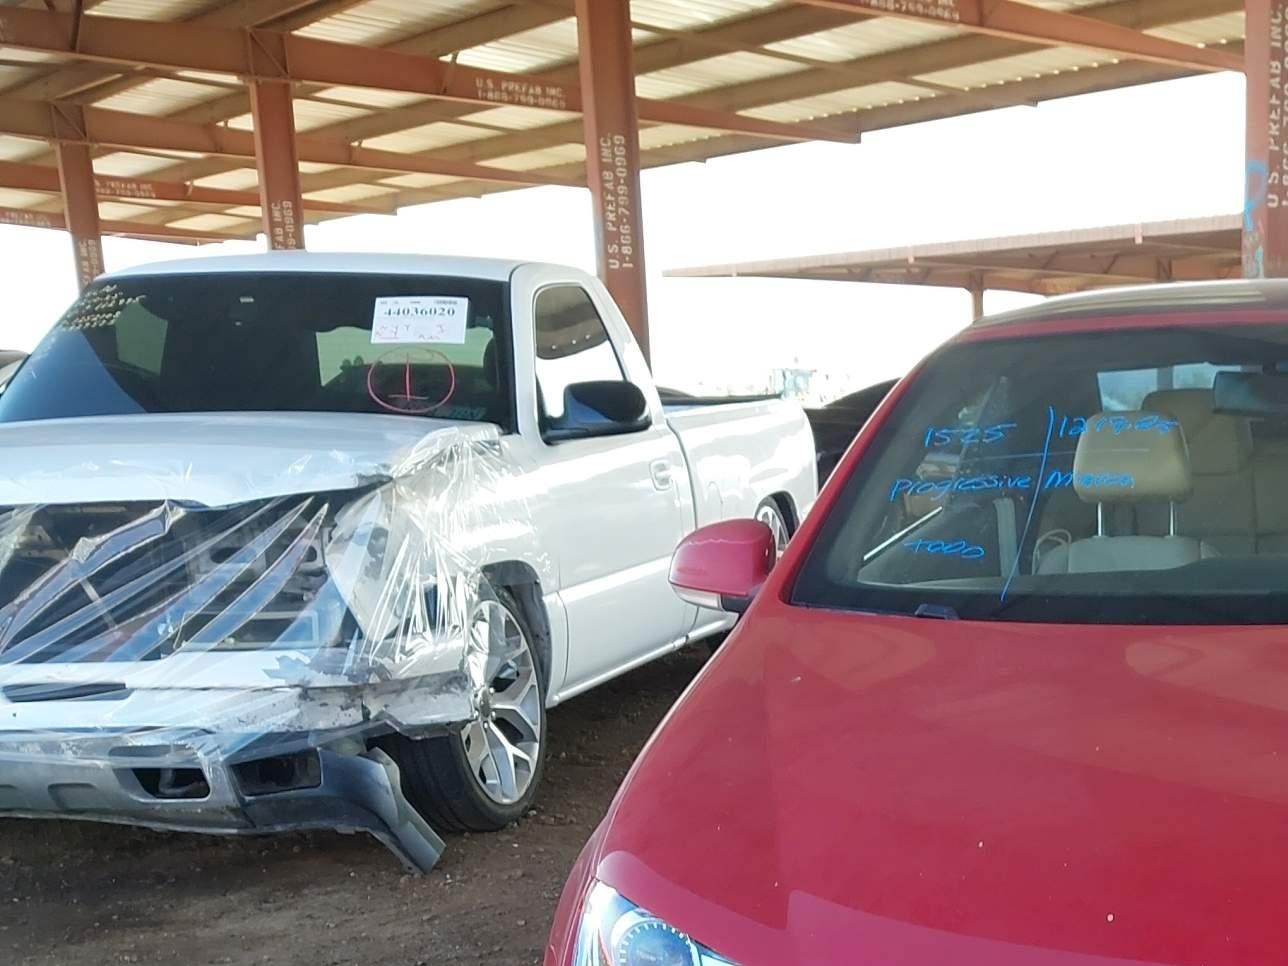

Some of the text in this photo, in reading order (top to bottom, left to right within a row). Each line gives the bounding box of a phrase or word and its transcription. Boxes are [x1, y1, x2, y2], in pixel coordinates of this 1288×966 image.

[1268, 60, 1282, 151] PREFAB
[602, 170, 617, 232] PREFAB
[614, 135, 634, 268] 1-866-799-0969
[384, 306, 455, 317] 44036020
